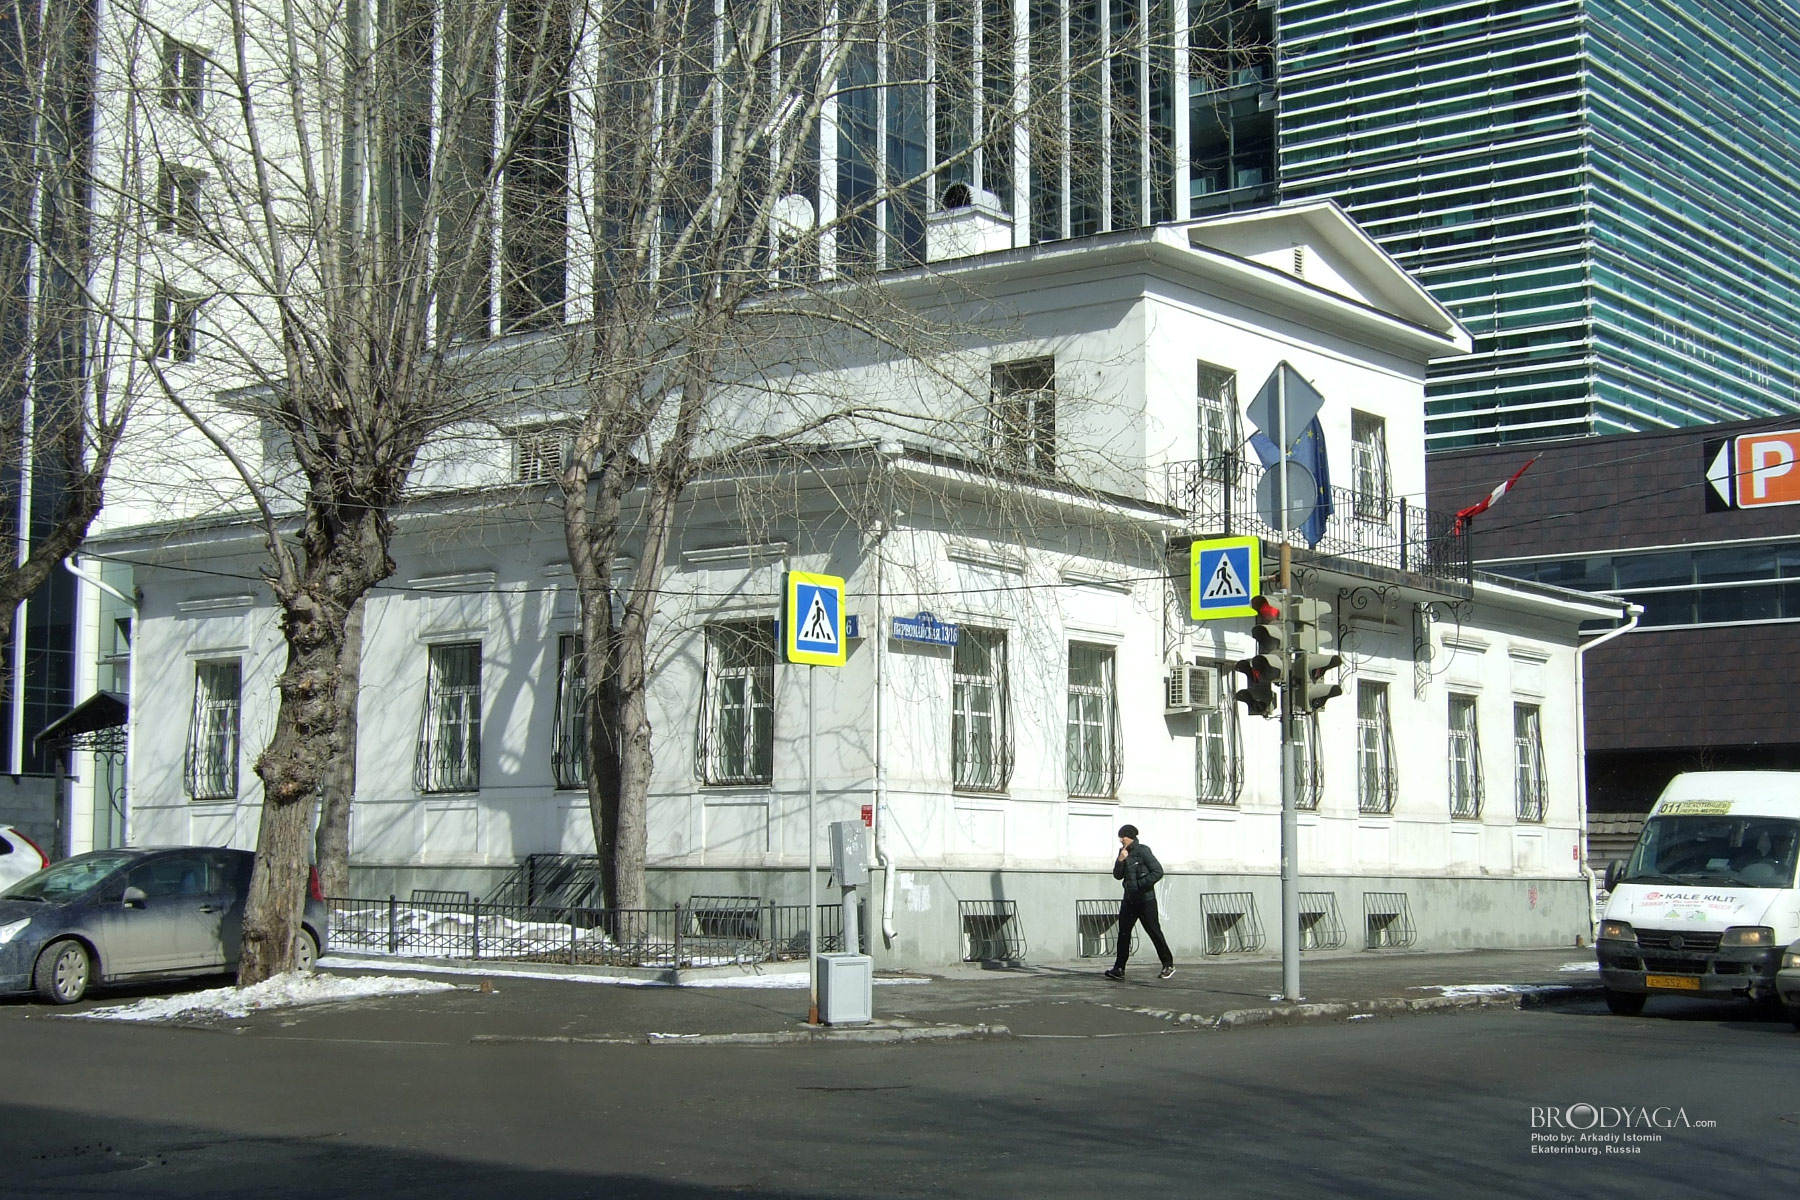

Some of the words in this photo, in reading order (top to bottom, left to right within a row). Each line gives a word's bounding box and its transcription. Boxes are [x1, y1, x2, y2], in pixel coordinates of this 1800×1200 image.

[1752, 441, 1794, 499] P
[1660, 803, 1681, 814] 011
[1704, 894, 1737, 903] KILIT
